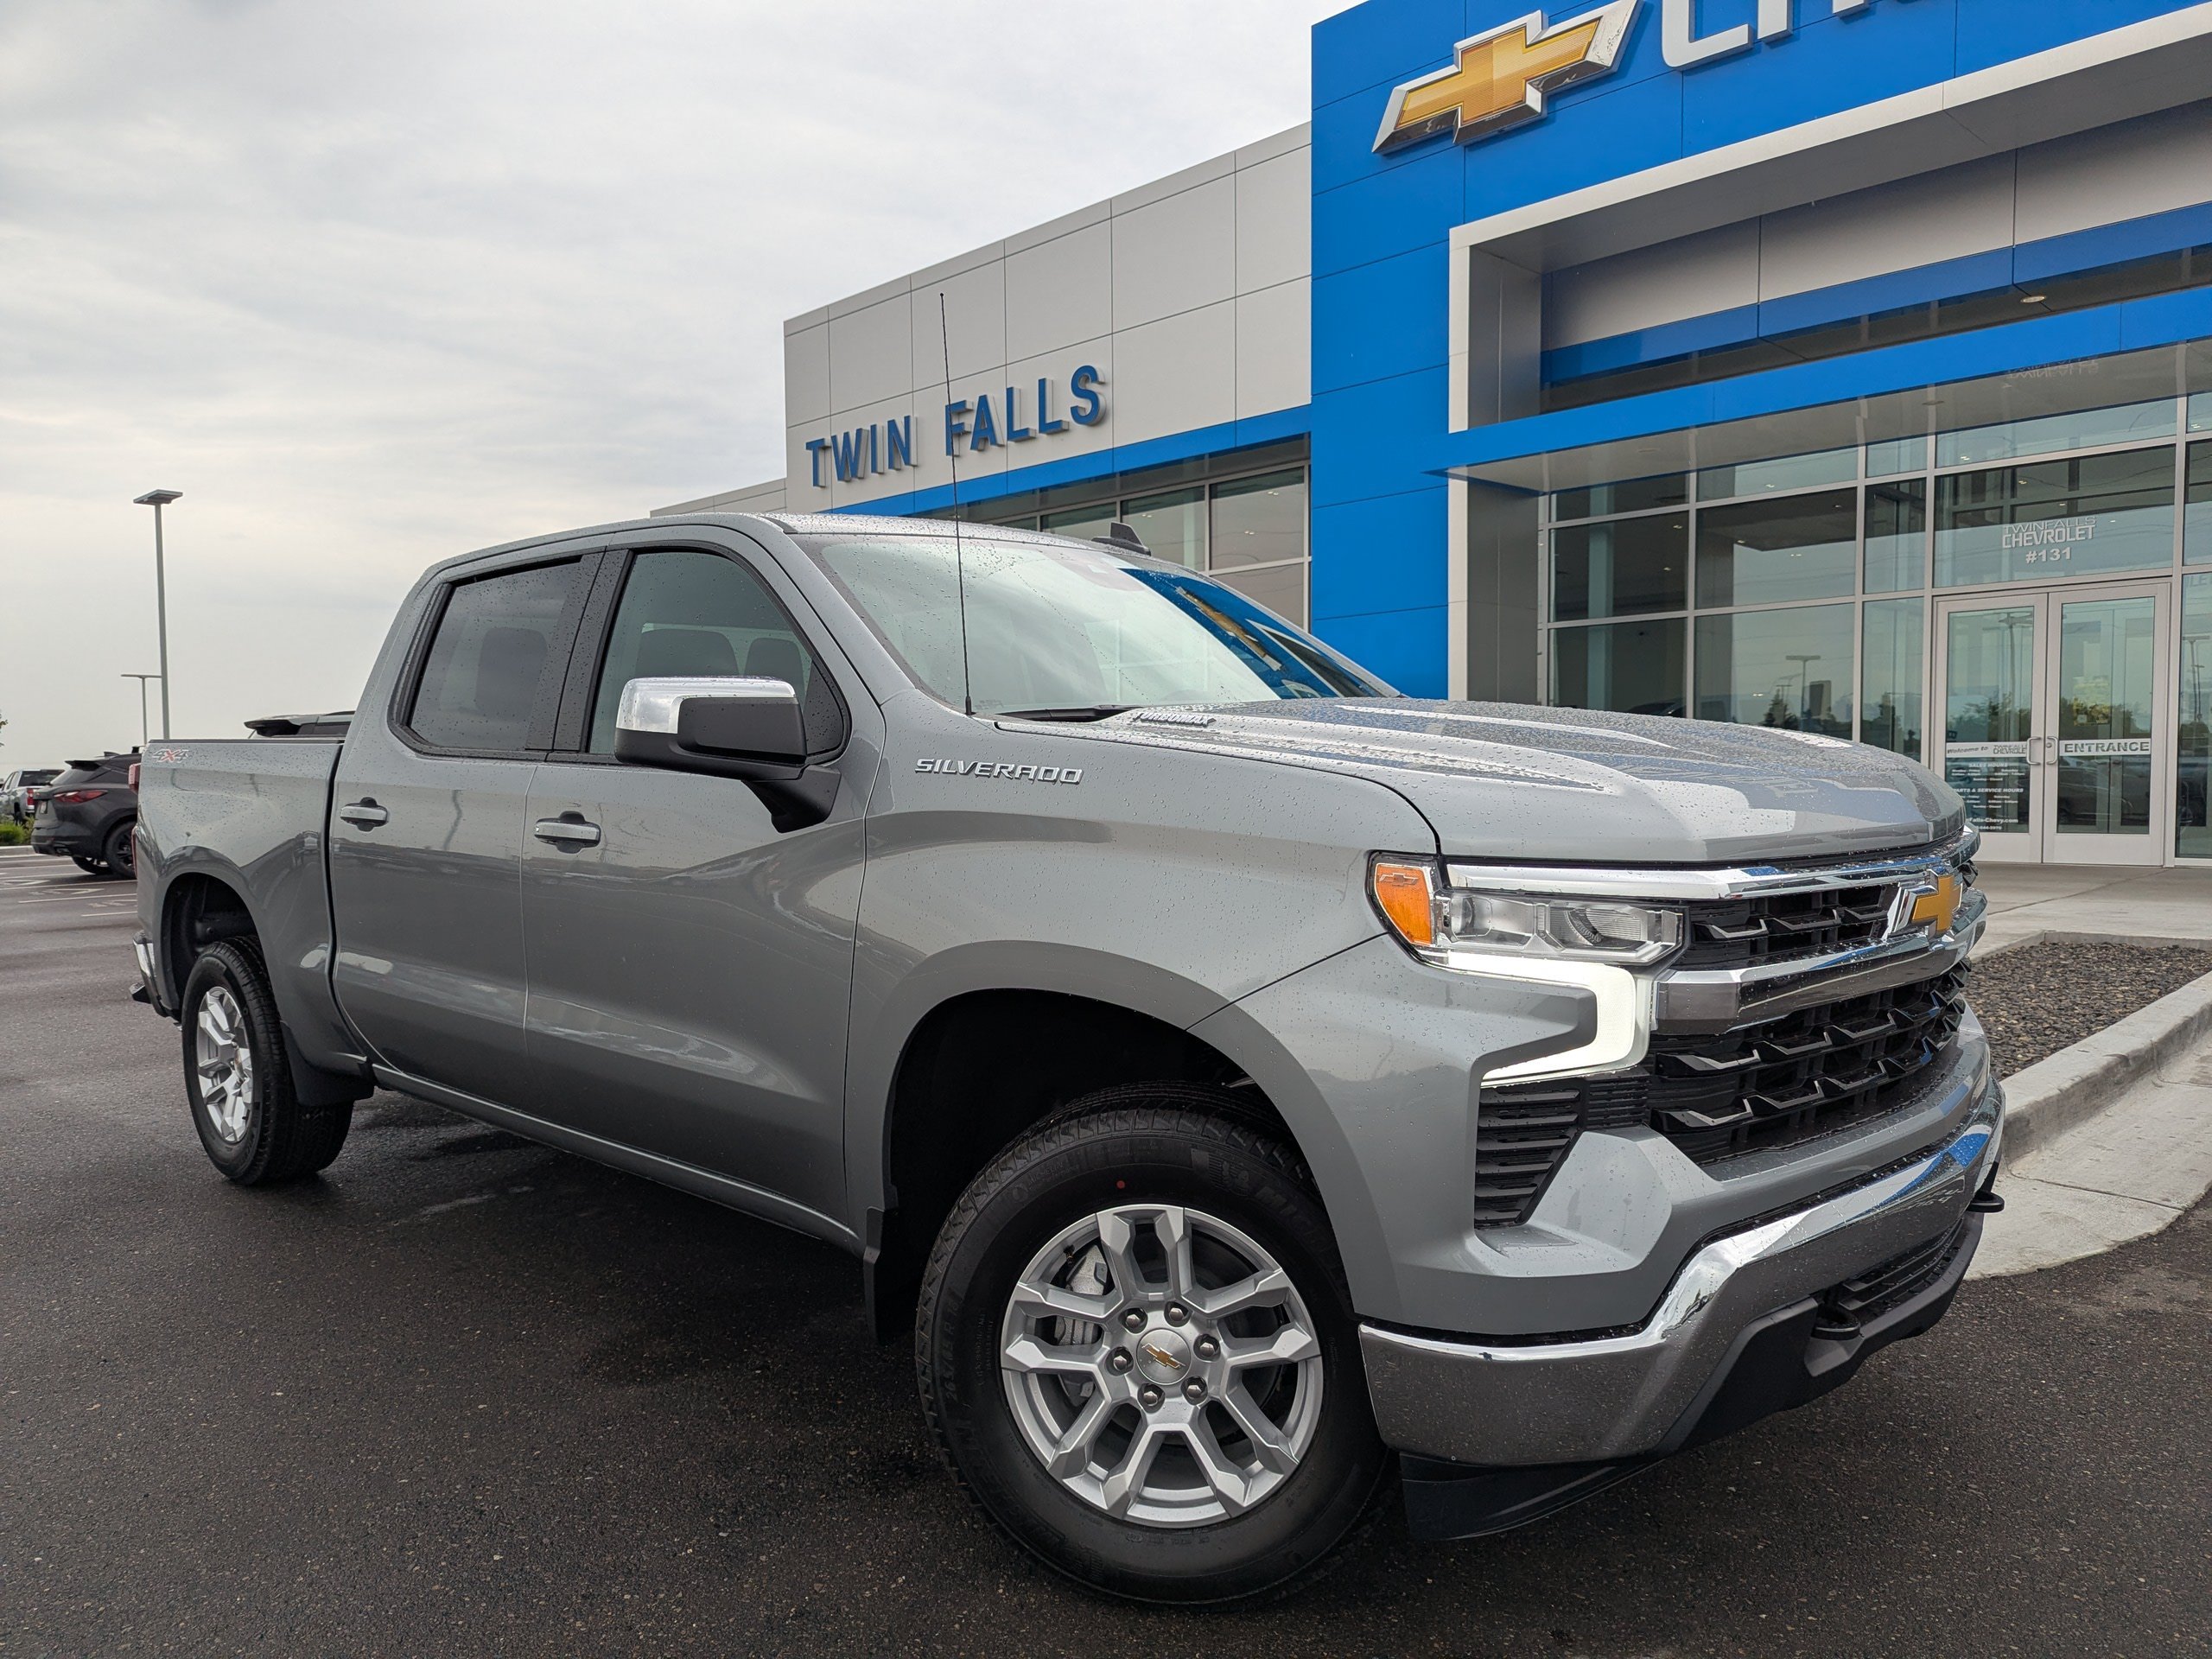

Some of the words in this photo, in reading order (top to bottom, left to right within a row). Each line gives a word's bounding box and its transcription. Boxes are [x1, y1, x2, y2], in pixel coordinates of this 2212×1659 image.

[805, 415, 918, 488] TWIN
[944, 365, 1107, 457] FALLS
[2003, 524, 2096, 549] CHEVROLET
[2025, 546, 2072, 563] #131
[2064, 741, 2150, 753] ENTRANCE
[915, 758, 1084, 785] SILVERADO
